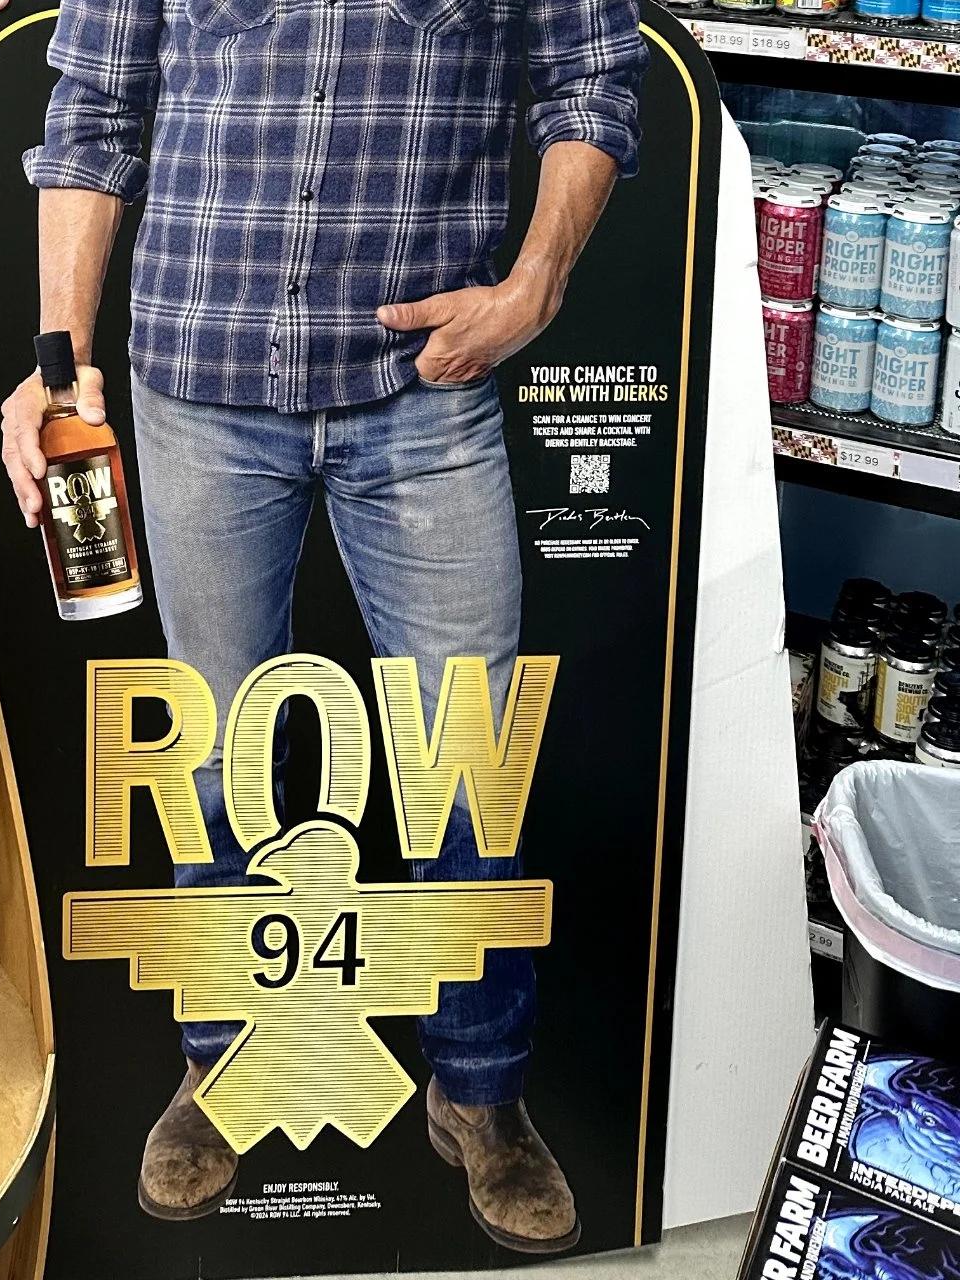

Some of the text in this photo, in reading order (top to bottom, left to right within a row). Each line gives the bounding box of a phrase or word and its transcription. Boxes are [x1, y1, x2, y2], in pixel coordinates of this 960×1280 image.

[706, 34, 743, 46] $18.99
[751, 38, 790, 50] $18.99
[825, 242, 879, 261] RIGHT
[825, 258, 876, 274] PROPER
[890, 251, 945, 271] RIGHT
[889, 269, 943, 286] PROPER
[531, 366, 657, 384] YOUR CHANCE TO
[876, 356, 928, 377] RIGHT
[875, 373, 926, 391] PROPER
[518, 385, 668, 402] DRINK WITH DIERKS
[533, 414, 652, 424] SCAN FOR A CHANCE TO WIN CONCERT
[533, 426, 651, 436] TICKETS AND SHARE A COCKTAIL WITH
[545, 438, 637, 448] DIERKS BENTLEY BACKSTAGE.
[840, 451, 879, 466] $12.99
[47, 467, 112, 506] ROW
[896, 693, 927, 705] SOUTH
[896, 702, 917, 715] SIDE
[896, 713, 911, 724] IPA
[85, 652, 561, 867] ROW
[249, 910, 366, 990] 94
[797, 1027, 860, 1168] BEER FARM
[263, 1181, 339, 1193] ENJOY RESPONSIBLY.
[849, 1172, 935, 1214] INDIA PALE ALE
[770, 1175, 820, 1259] FARM
[807, 1216, 827, 1254] BREWERY
